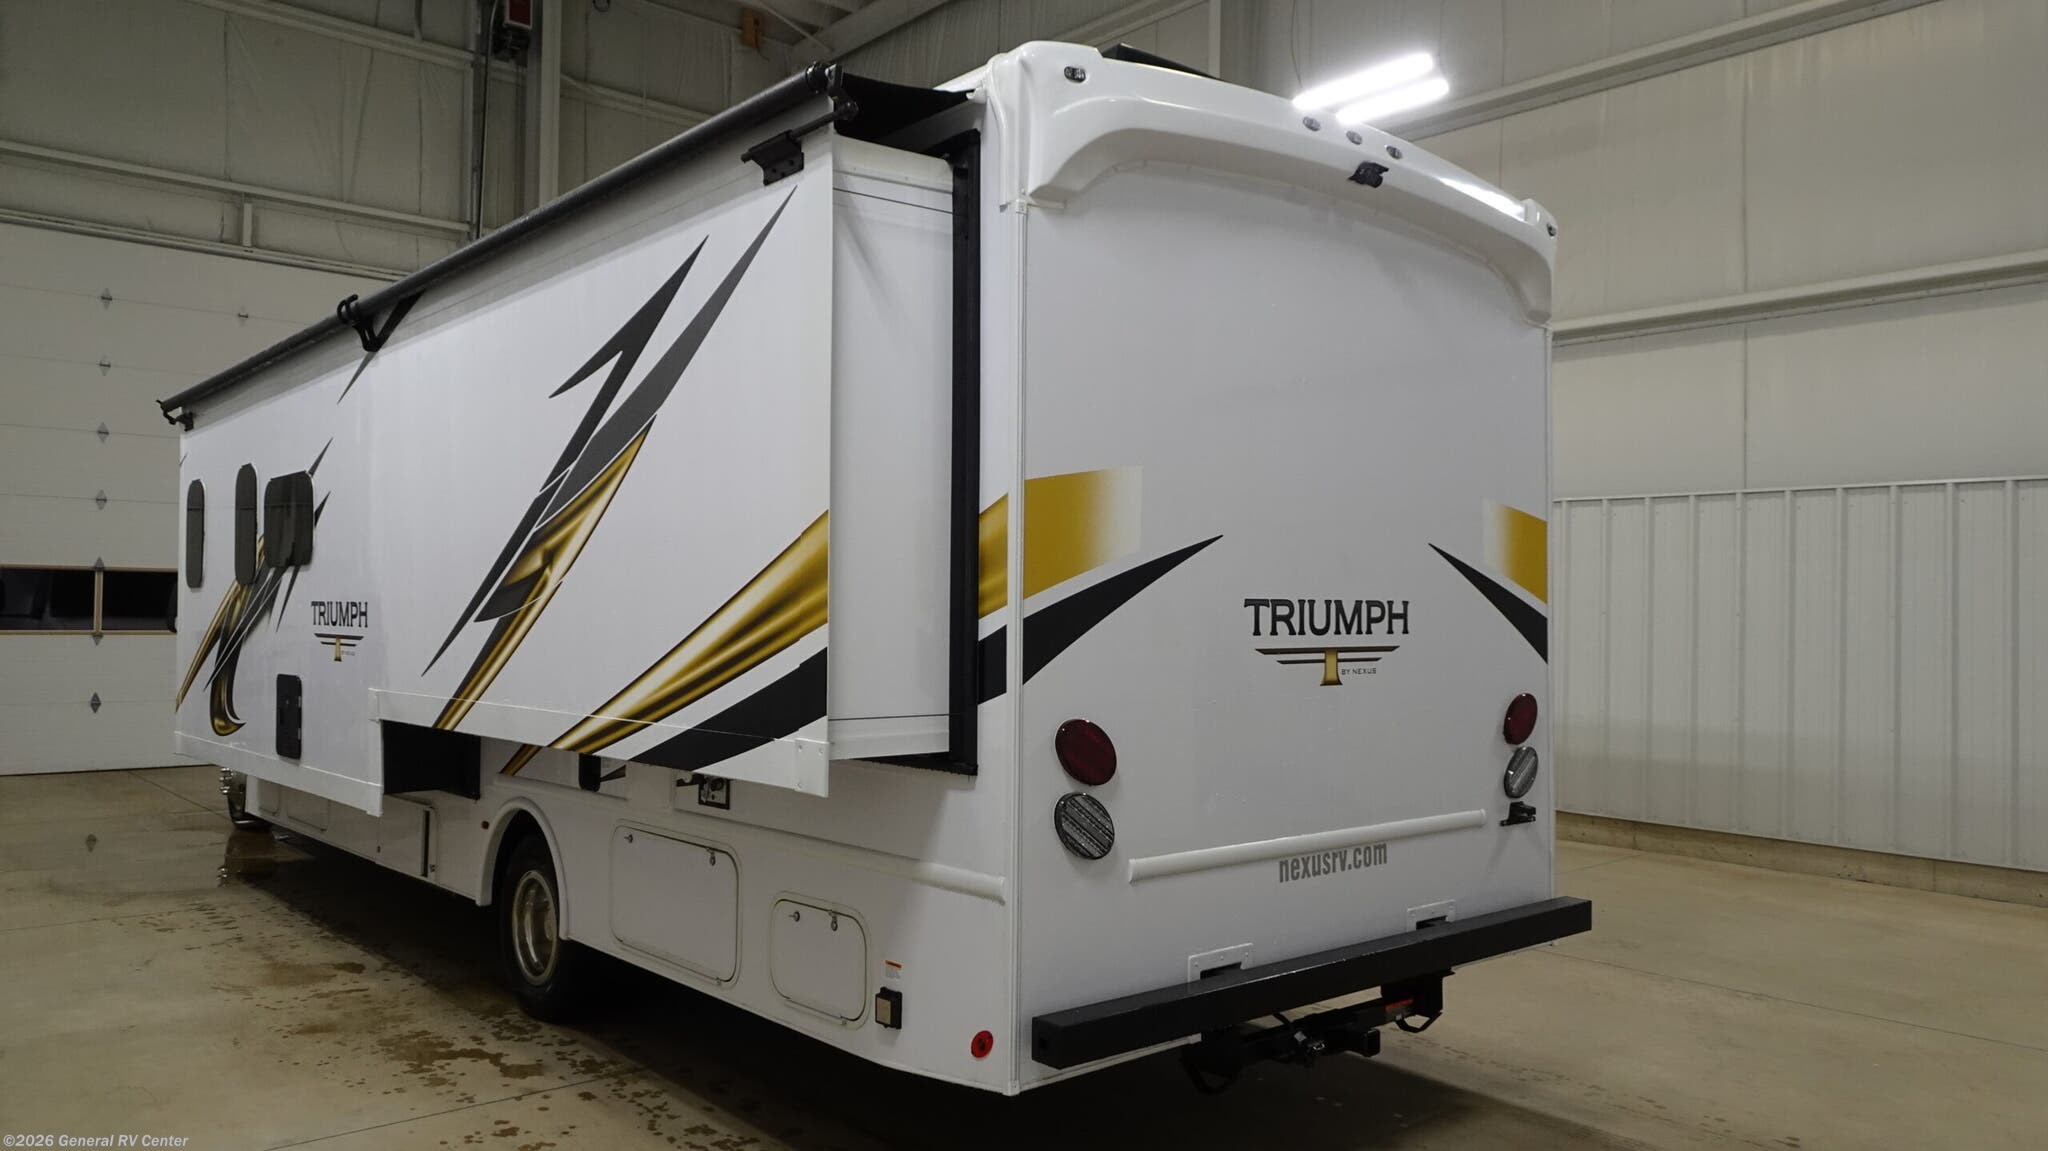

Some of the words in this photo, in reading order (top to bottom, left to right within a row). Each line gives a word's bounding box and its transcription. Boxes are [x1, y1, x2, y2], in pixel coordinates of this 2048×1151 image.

[311, 600, 368, 628] TRIUMPH
[1244, 598, 1409, 636] TRIUMPH
[1341, 668, 1350, 676] BY
[1352, 667, 1377, 675] NEXUS
[1279, 842, 1388, 883] nexusrv.com
